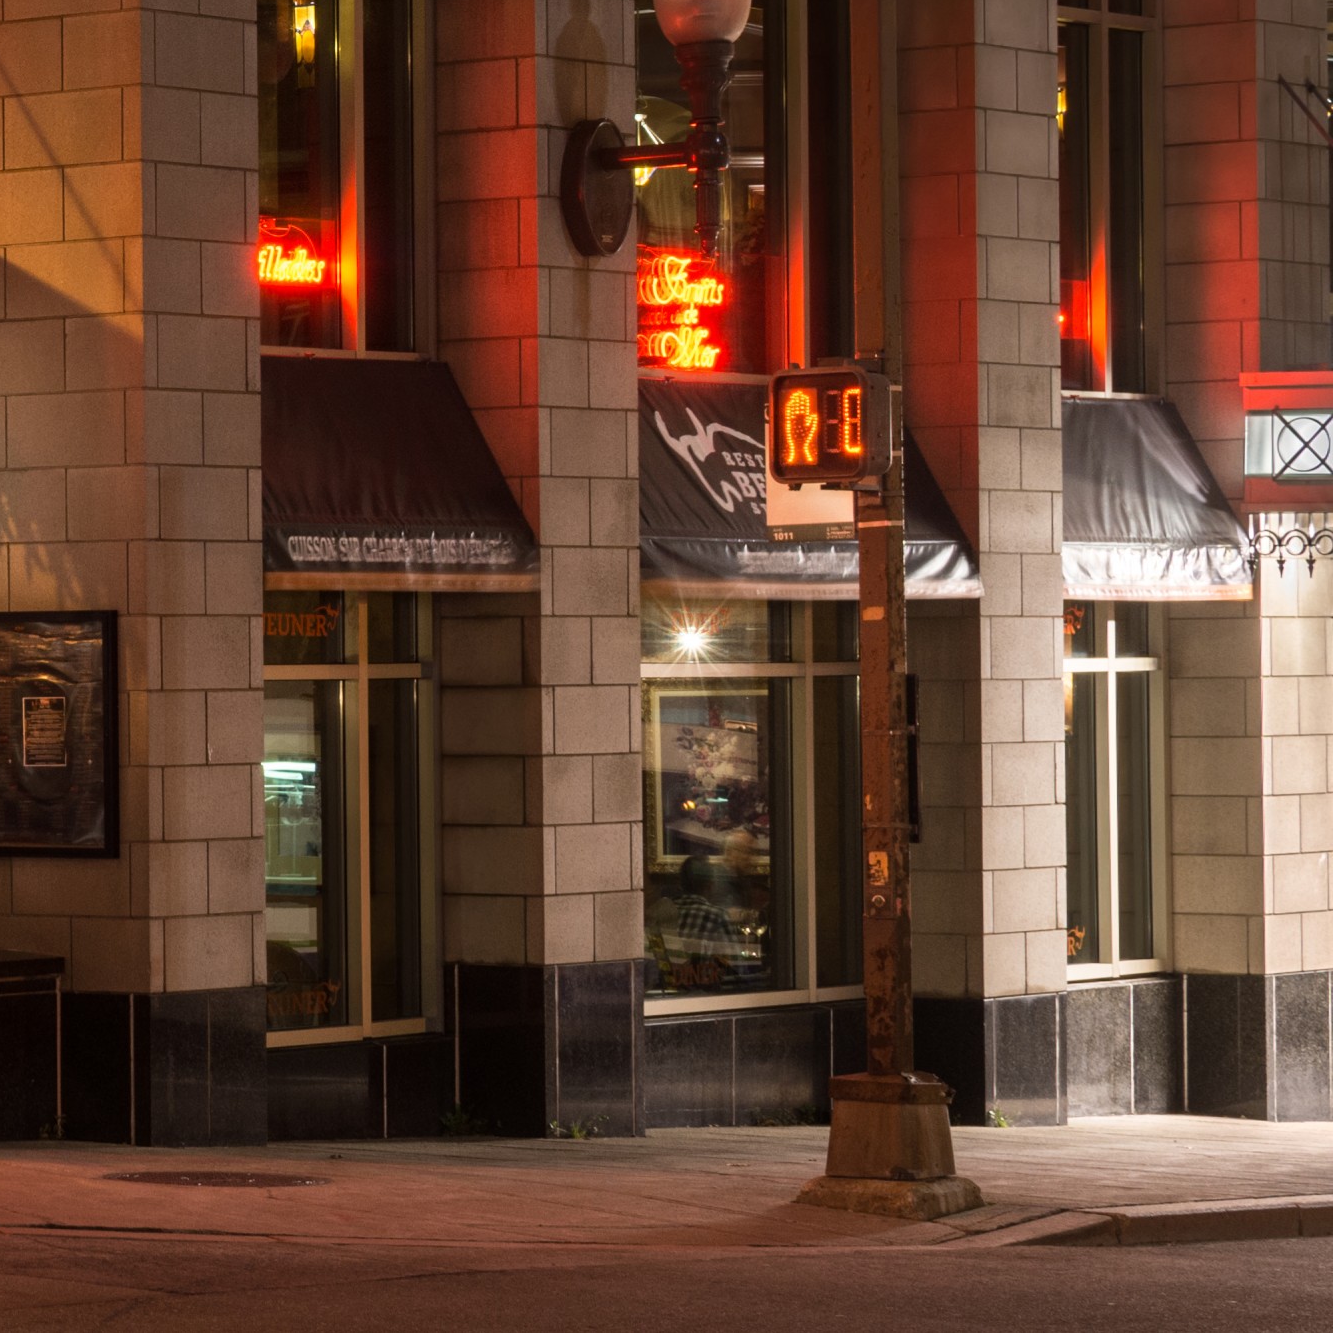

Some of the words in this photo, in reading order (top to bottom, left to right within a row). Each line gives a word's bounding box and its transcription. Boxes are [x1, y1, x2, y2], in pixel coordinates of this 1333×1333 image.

[258, 244, 326, 284] illades
[773, 532, 794, 541] 1011
[261, 613, 328, 637] JEUNER
